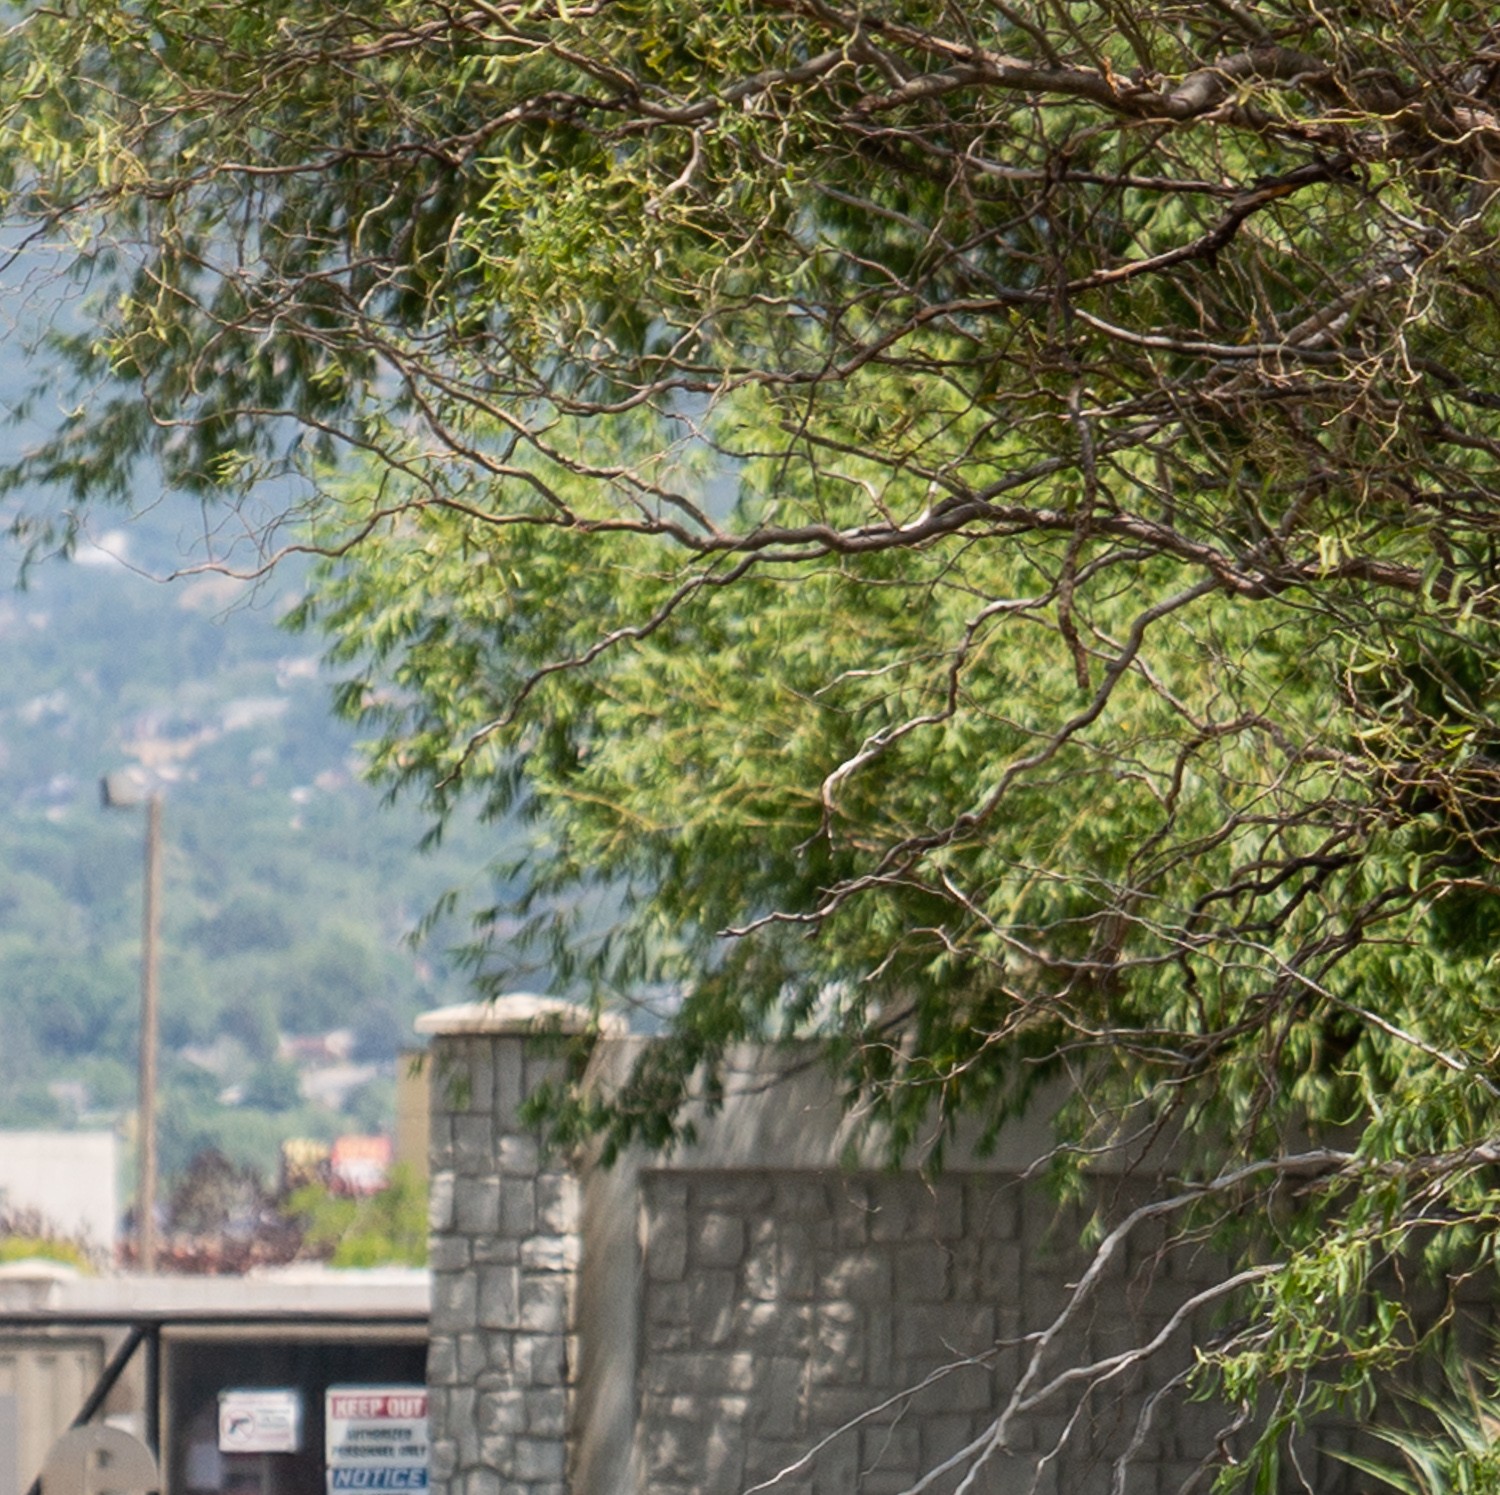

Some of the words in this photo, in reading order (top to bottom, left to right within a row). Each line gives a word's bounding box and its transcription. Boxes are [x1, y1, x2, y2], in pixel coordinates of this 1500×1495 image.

[336, 1398, 382, 1417] KEEP
[387, 1397, 424, 1417] OUT
[335, 1468, 423, 1487] NOTICE
